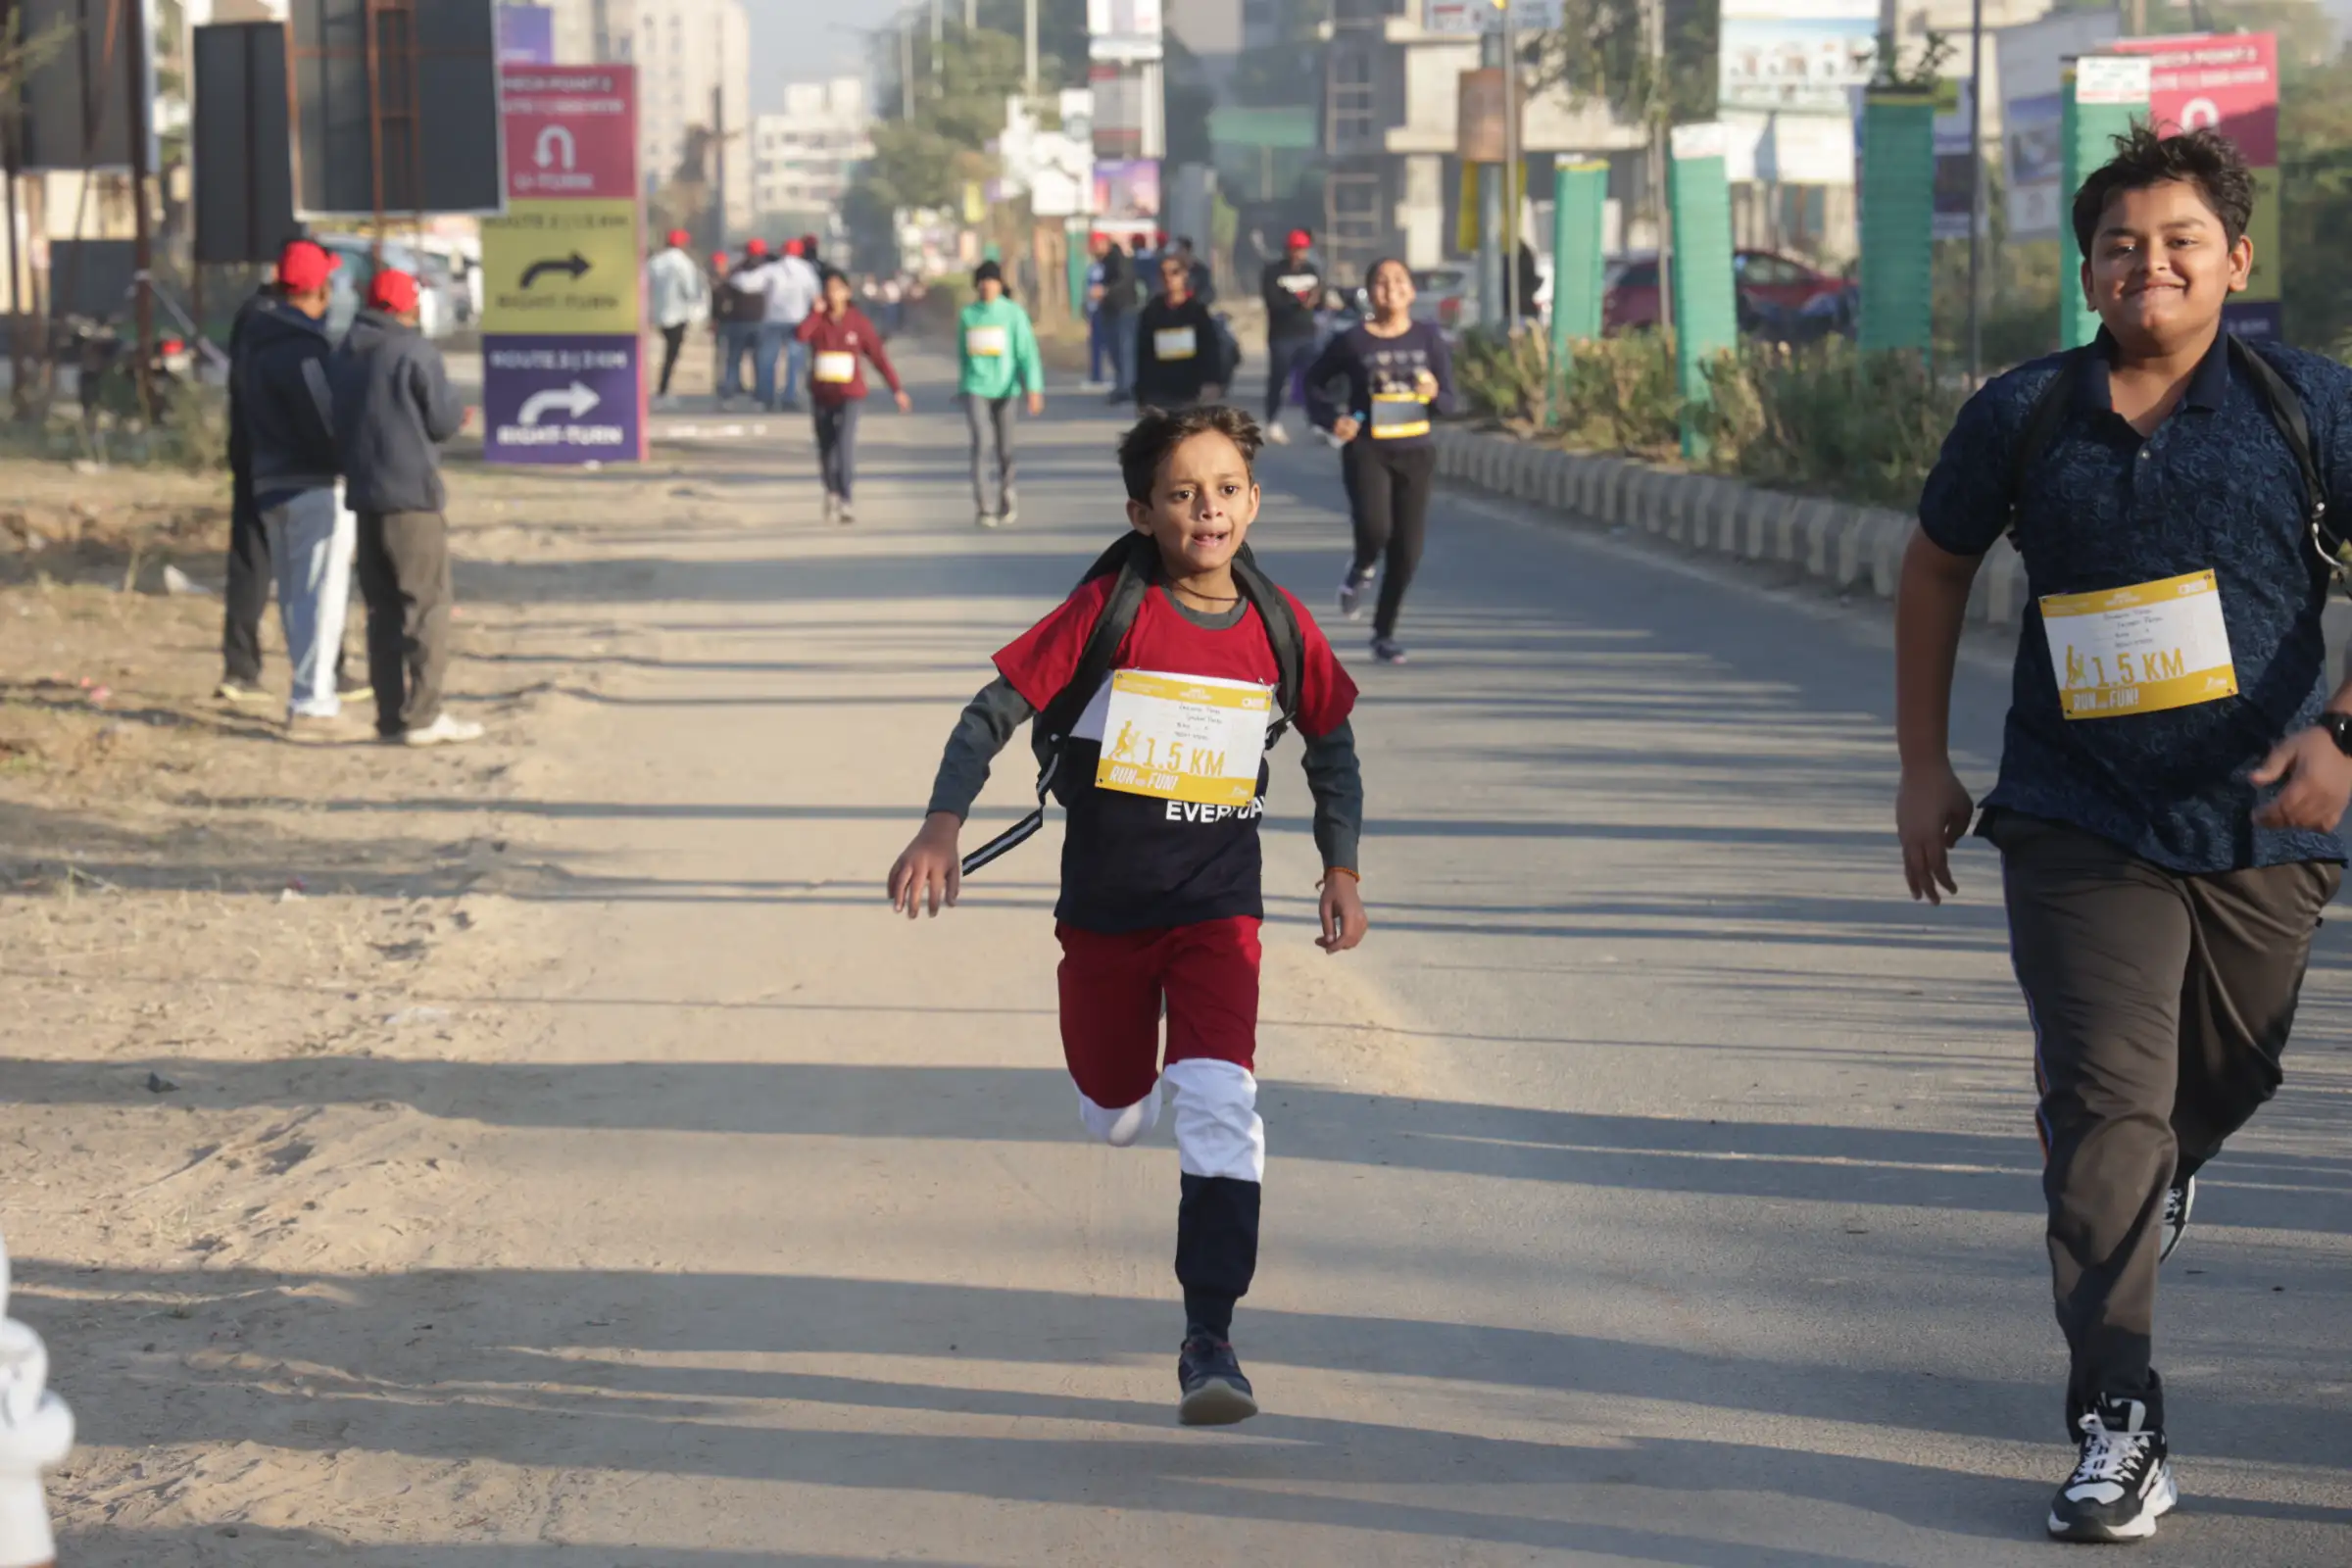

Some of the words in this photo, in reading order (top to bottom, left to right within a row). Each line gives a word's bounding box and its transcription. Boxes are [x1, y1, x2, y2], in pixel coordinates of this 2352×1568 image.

[497, 424, 560, 446] RIGHT
[564, 424, 623, 446] TURN
[2091, 653, 2135, 688] 1.5
[2143, 648, 2185, 684] KM
[2073, 692, 2096, 710] RUN
[1143, 737, 1185, 772] 1.5
[1189, 747, 1225, 777] KM
[1109, 765, 1137, 785] RUN
